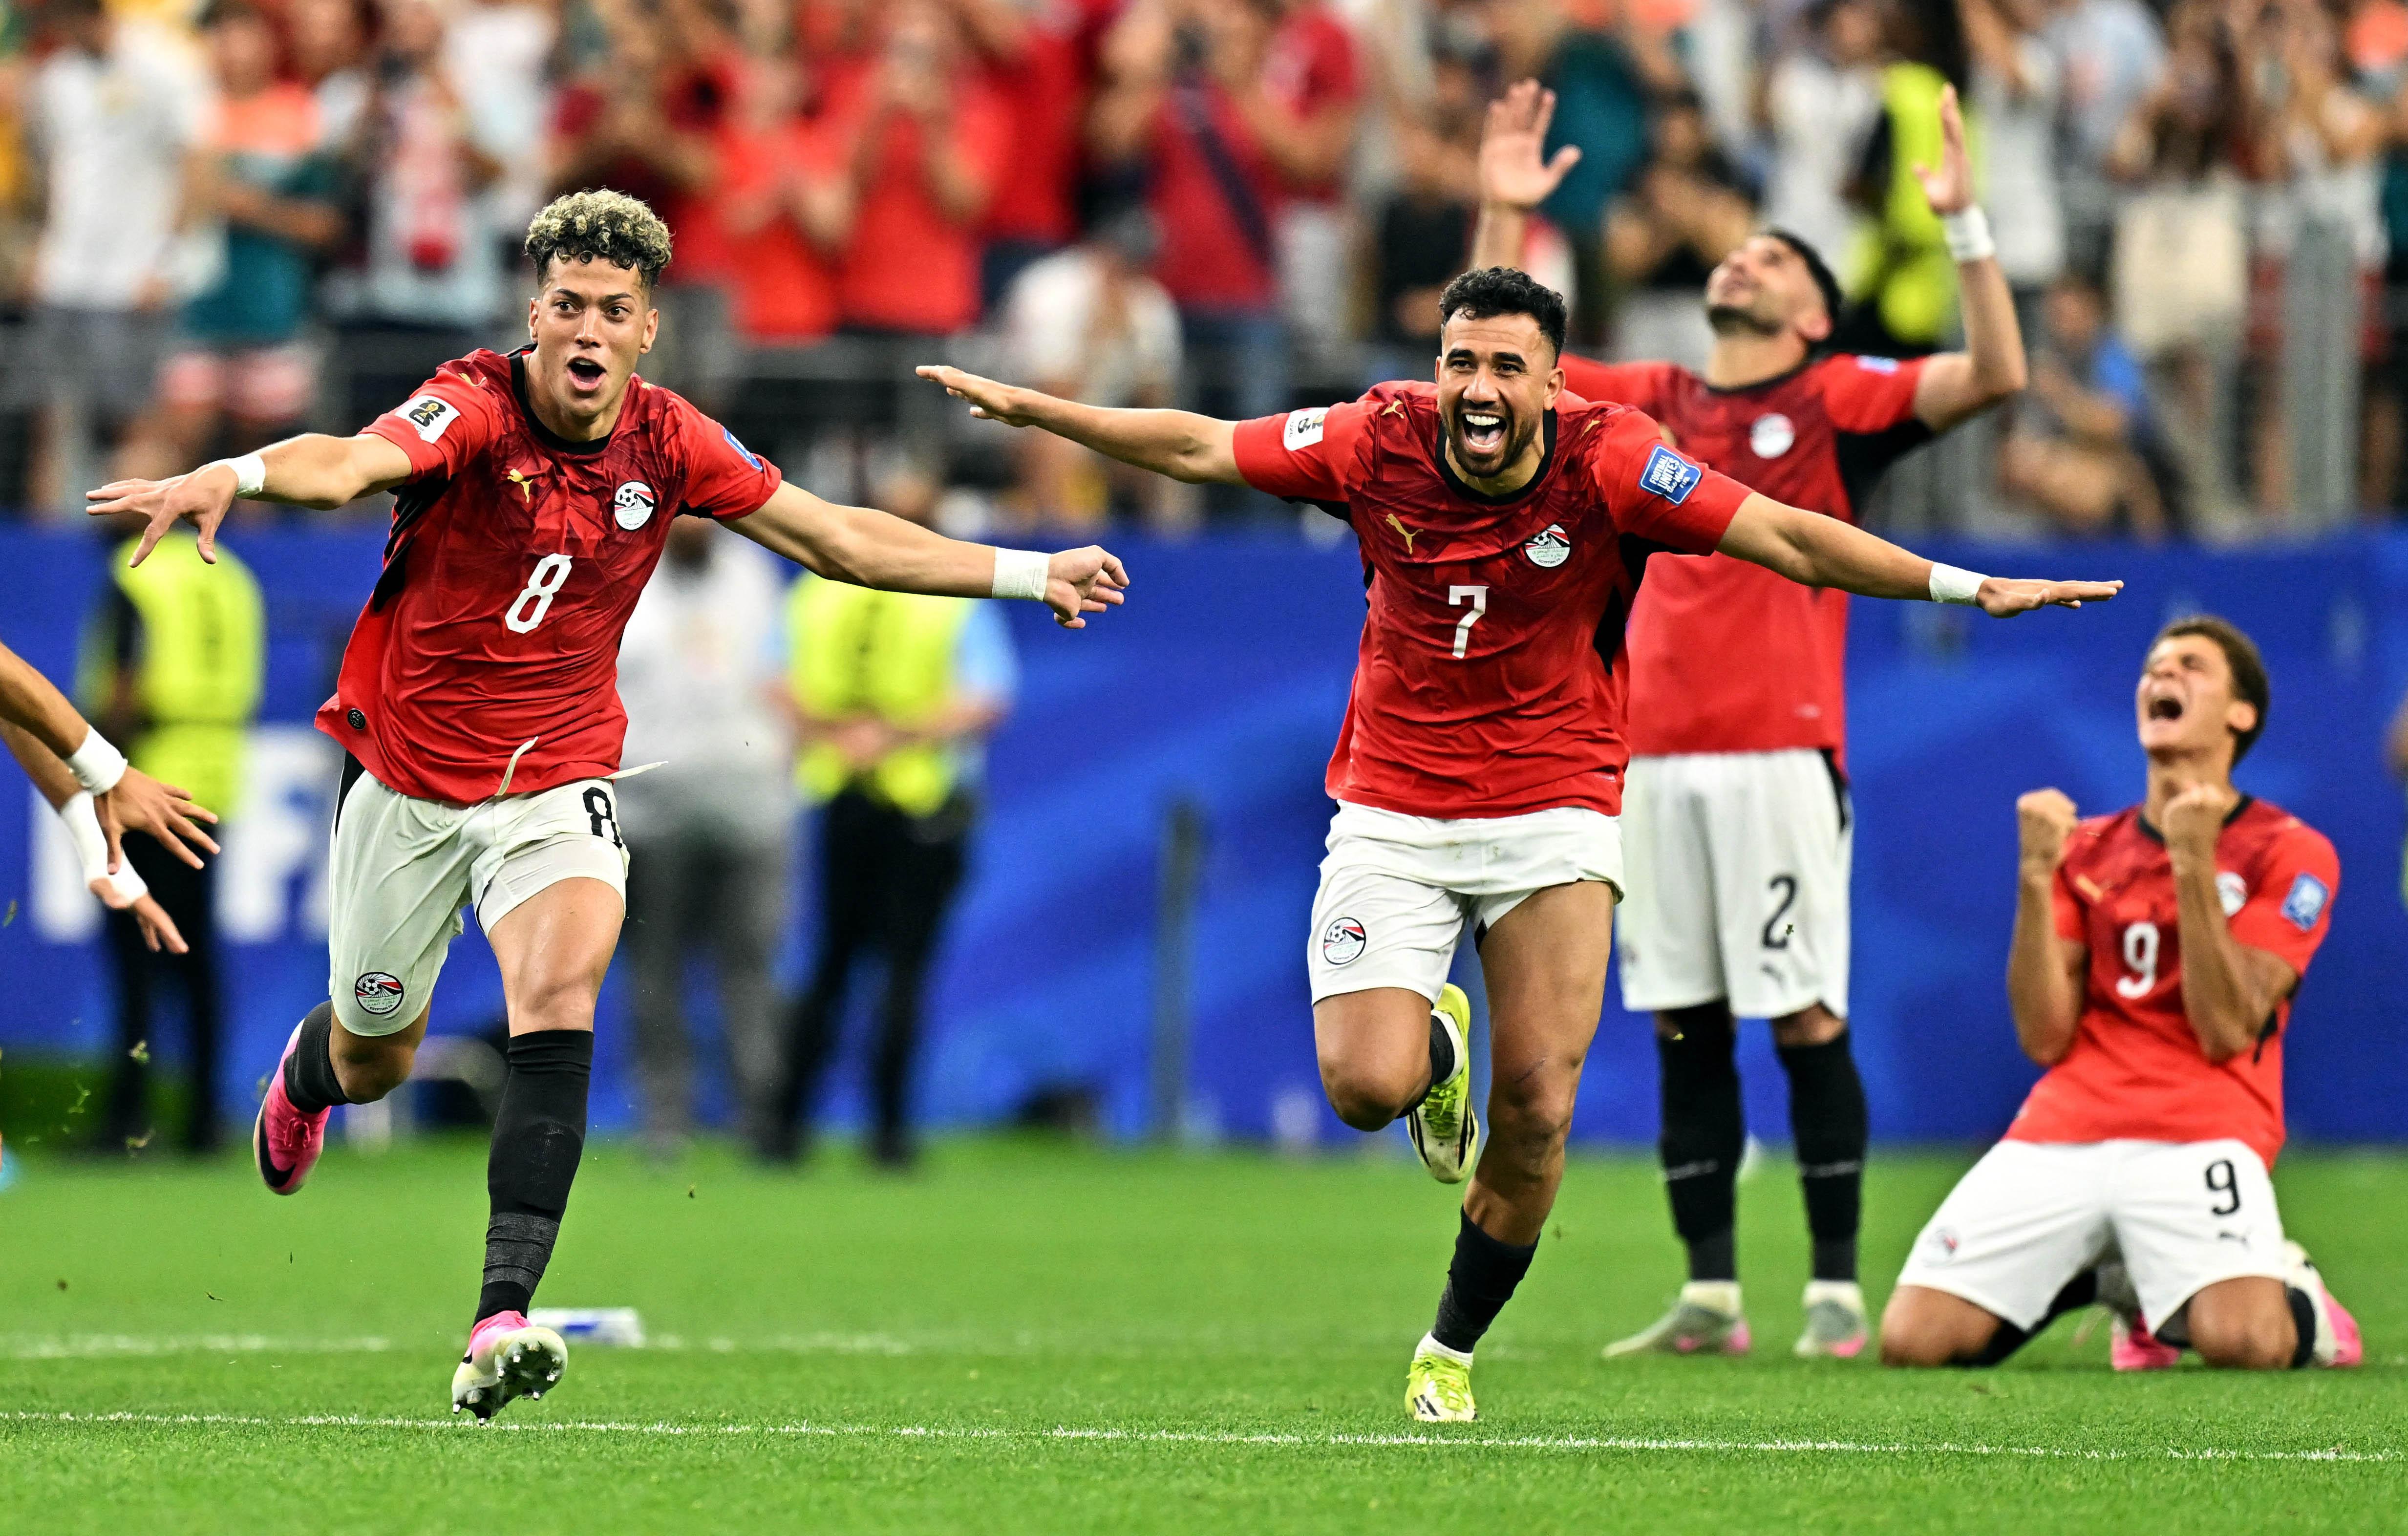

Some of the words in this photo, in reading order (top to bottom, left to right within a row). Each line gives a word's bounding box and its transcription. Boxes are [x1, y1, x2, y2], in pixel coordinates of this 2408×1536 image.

[1649, 455, 1669, 485] FOOTBALL
[1657, 458, 1680, 489] UNITES
[1679, 477, 1690, 489] FIFA
[505, 553, 573, 634] 8
[1449, 586, 1489, 660] 7
[582, 787, 622, 848] 8
[1763, 875, 1797, 949] 2
[2116, 921, 2160, 999] 9
[2204, 1159, 2240, 1216] 9
